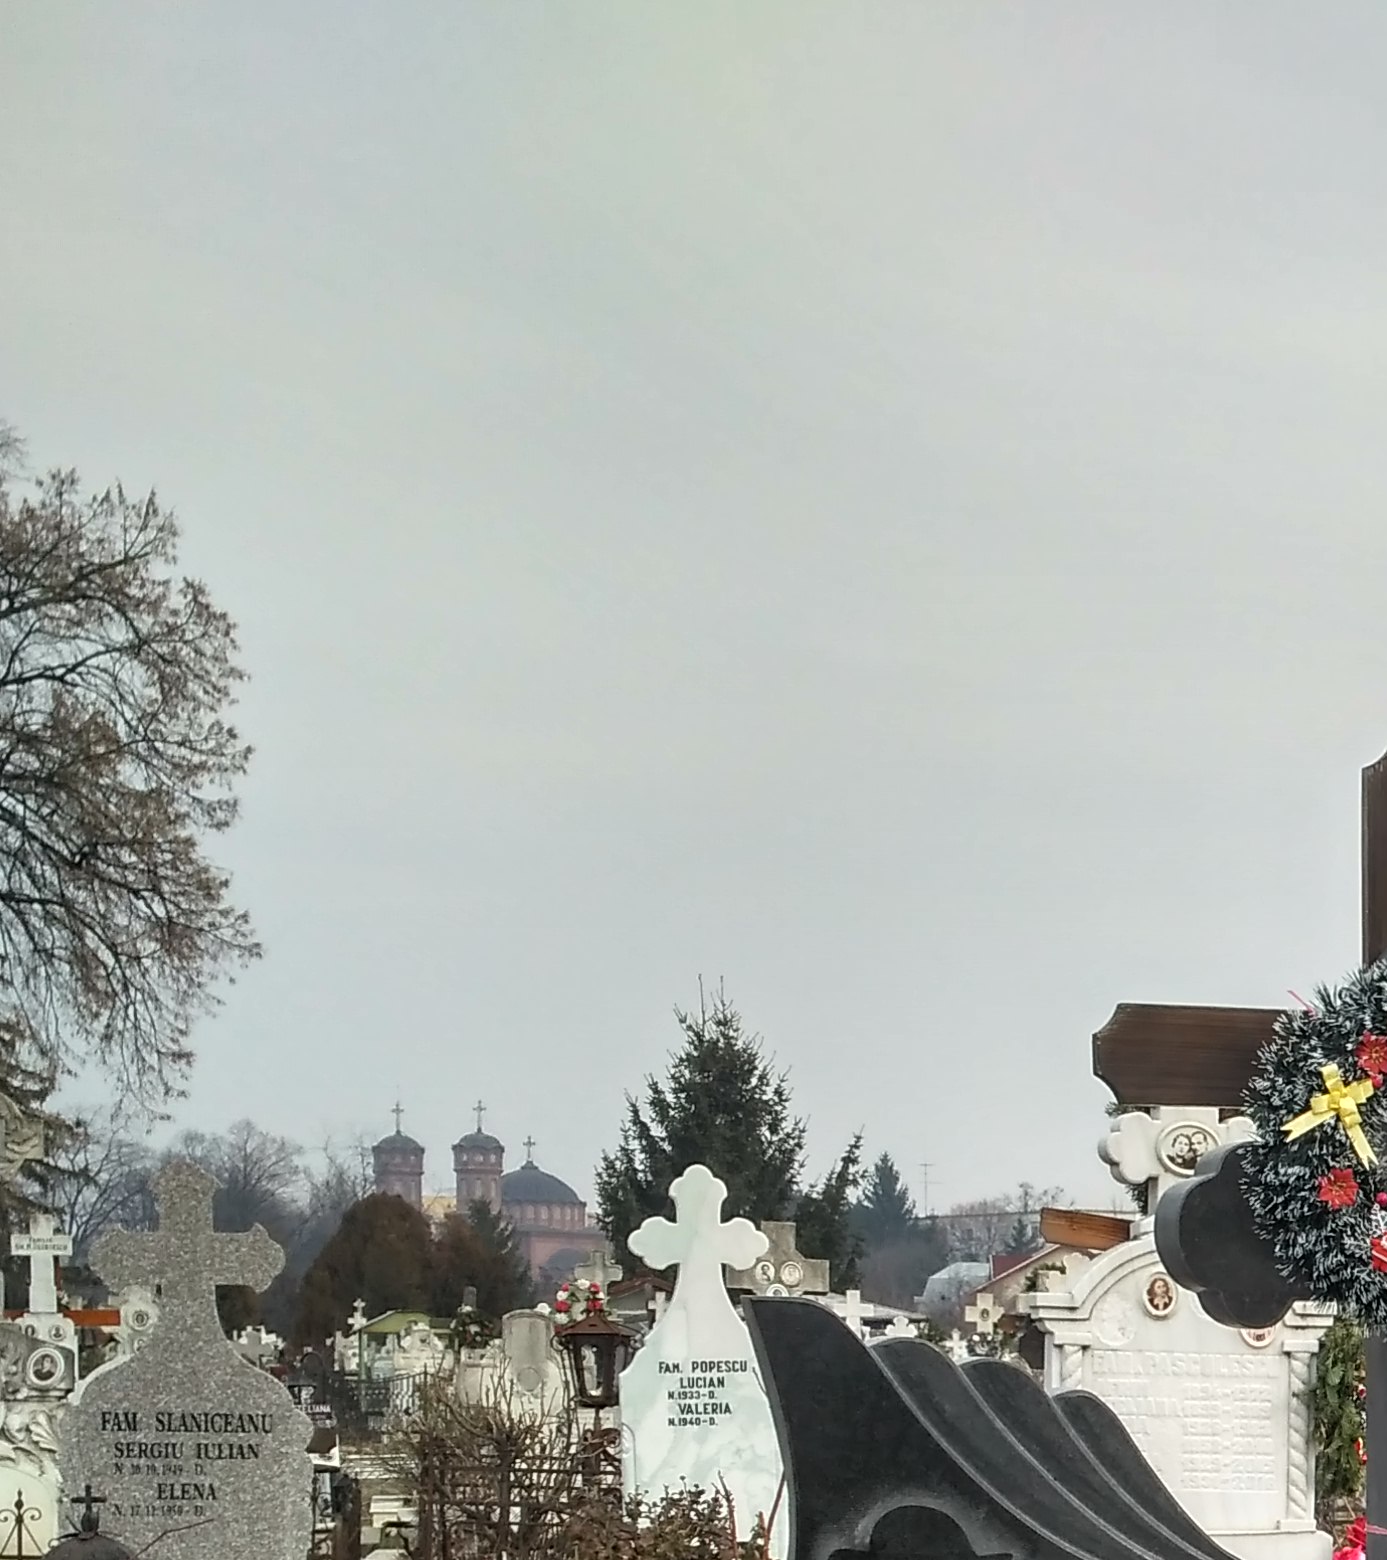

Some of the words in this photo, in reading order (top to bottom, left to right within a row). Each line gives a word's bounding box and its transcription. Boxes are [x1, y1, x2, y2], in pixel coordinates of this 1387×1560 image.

[691, 1360, 748, 1374] POPESCU
[680, 1376, 725, 1389] LUCIAN
[678, 1402, 732, 1416] VALERIA
[101, 1411, 137, 1432] FAM
[114, 1442, 182, 1459] SERGIU
[196, 1443, 260, 1460] IULIAN
[156, 1482, 218, 1501] ELENA
